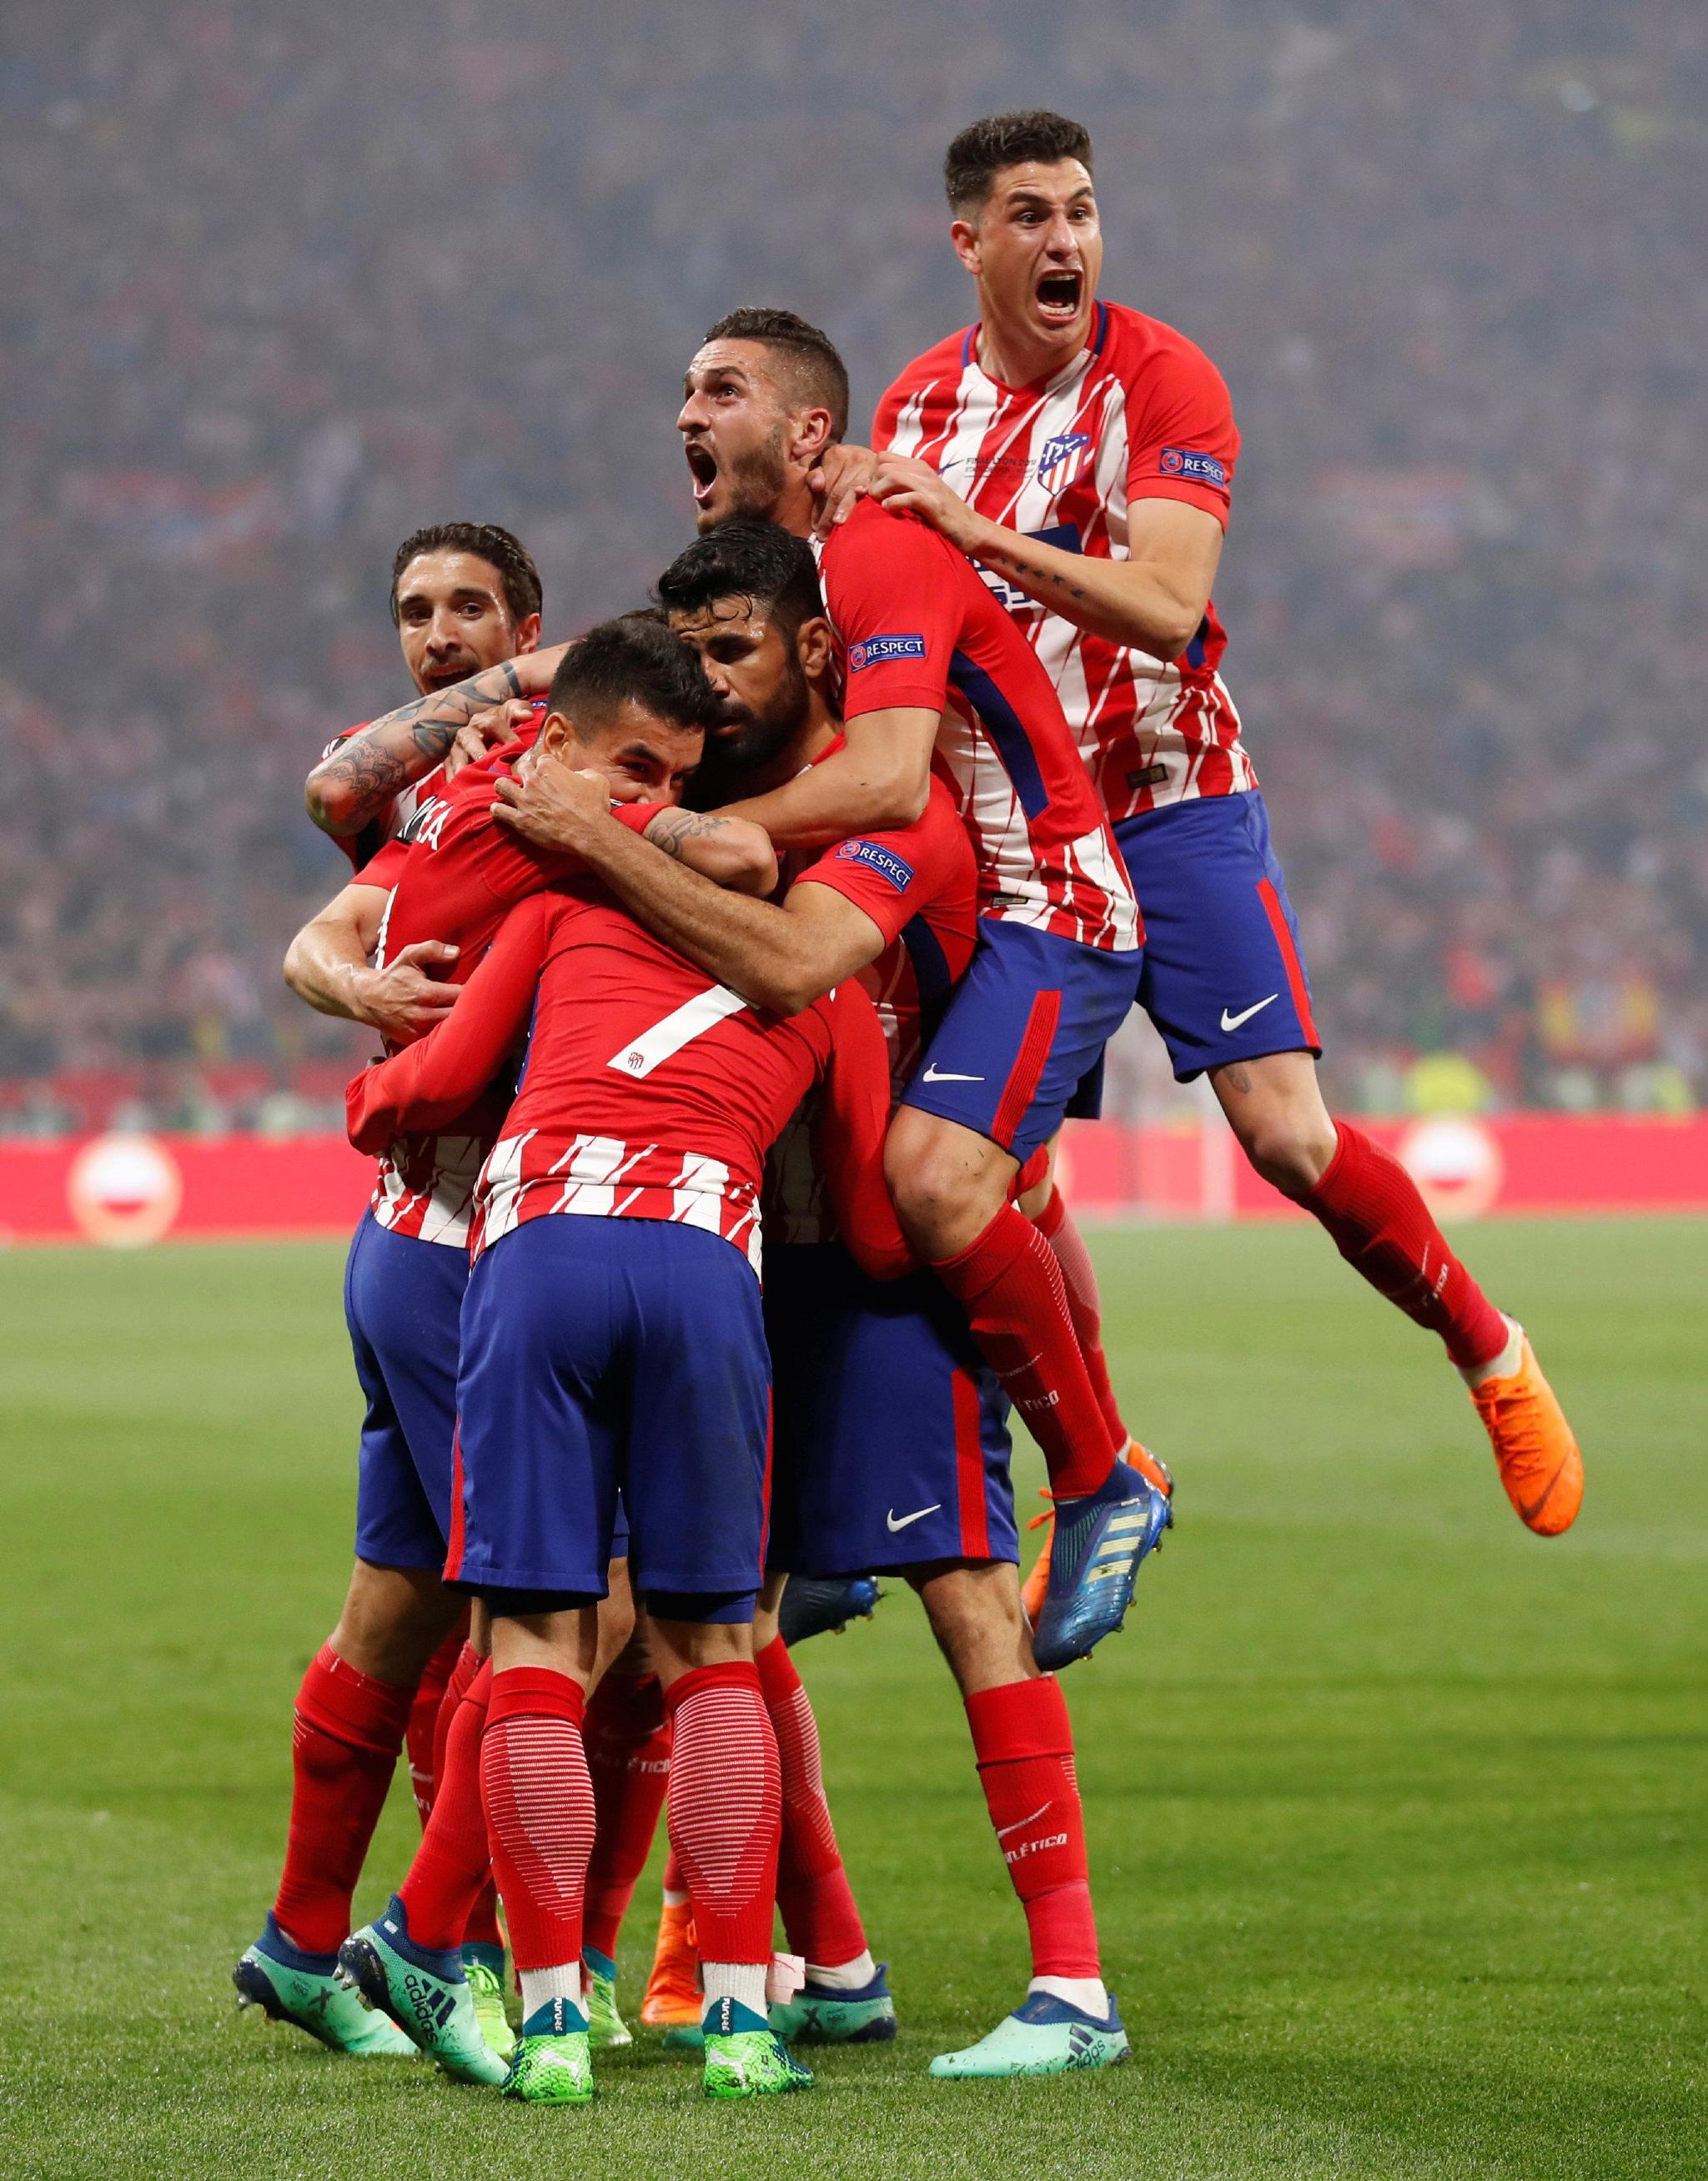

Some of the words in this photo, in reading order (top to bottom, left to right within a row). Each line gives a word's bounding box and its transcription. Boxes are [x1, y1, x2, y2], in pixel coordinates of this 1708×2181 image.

[867, 641, 923, 658] RESPECT
[859, 847, 911, 886] RESPECT
[606, 984, 761, 1079] 7
[404, 1974, 439, 2044] adidas
